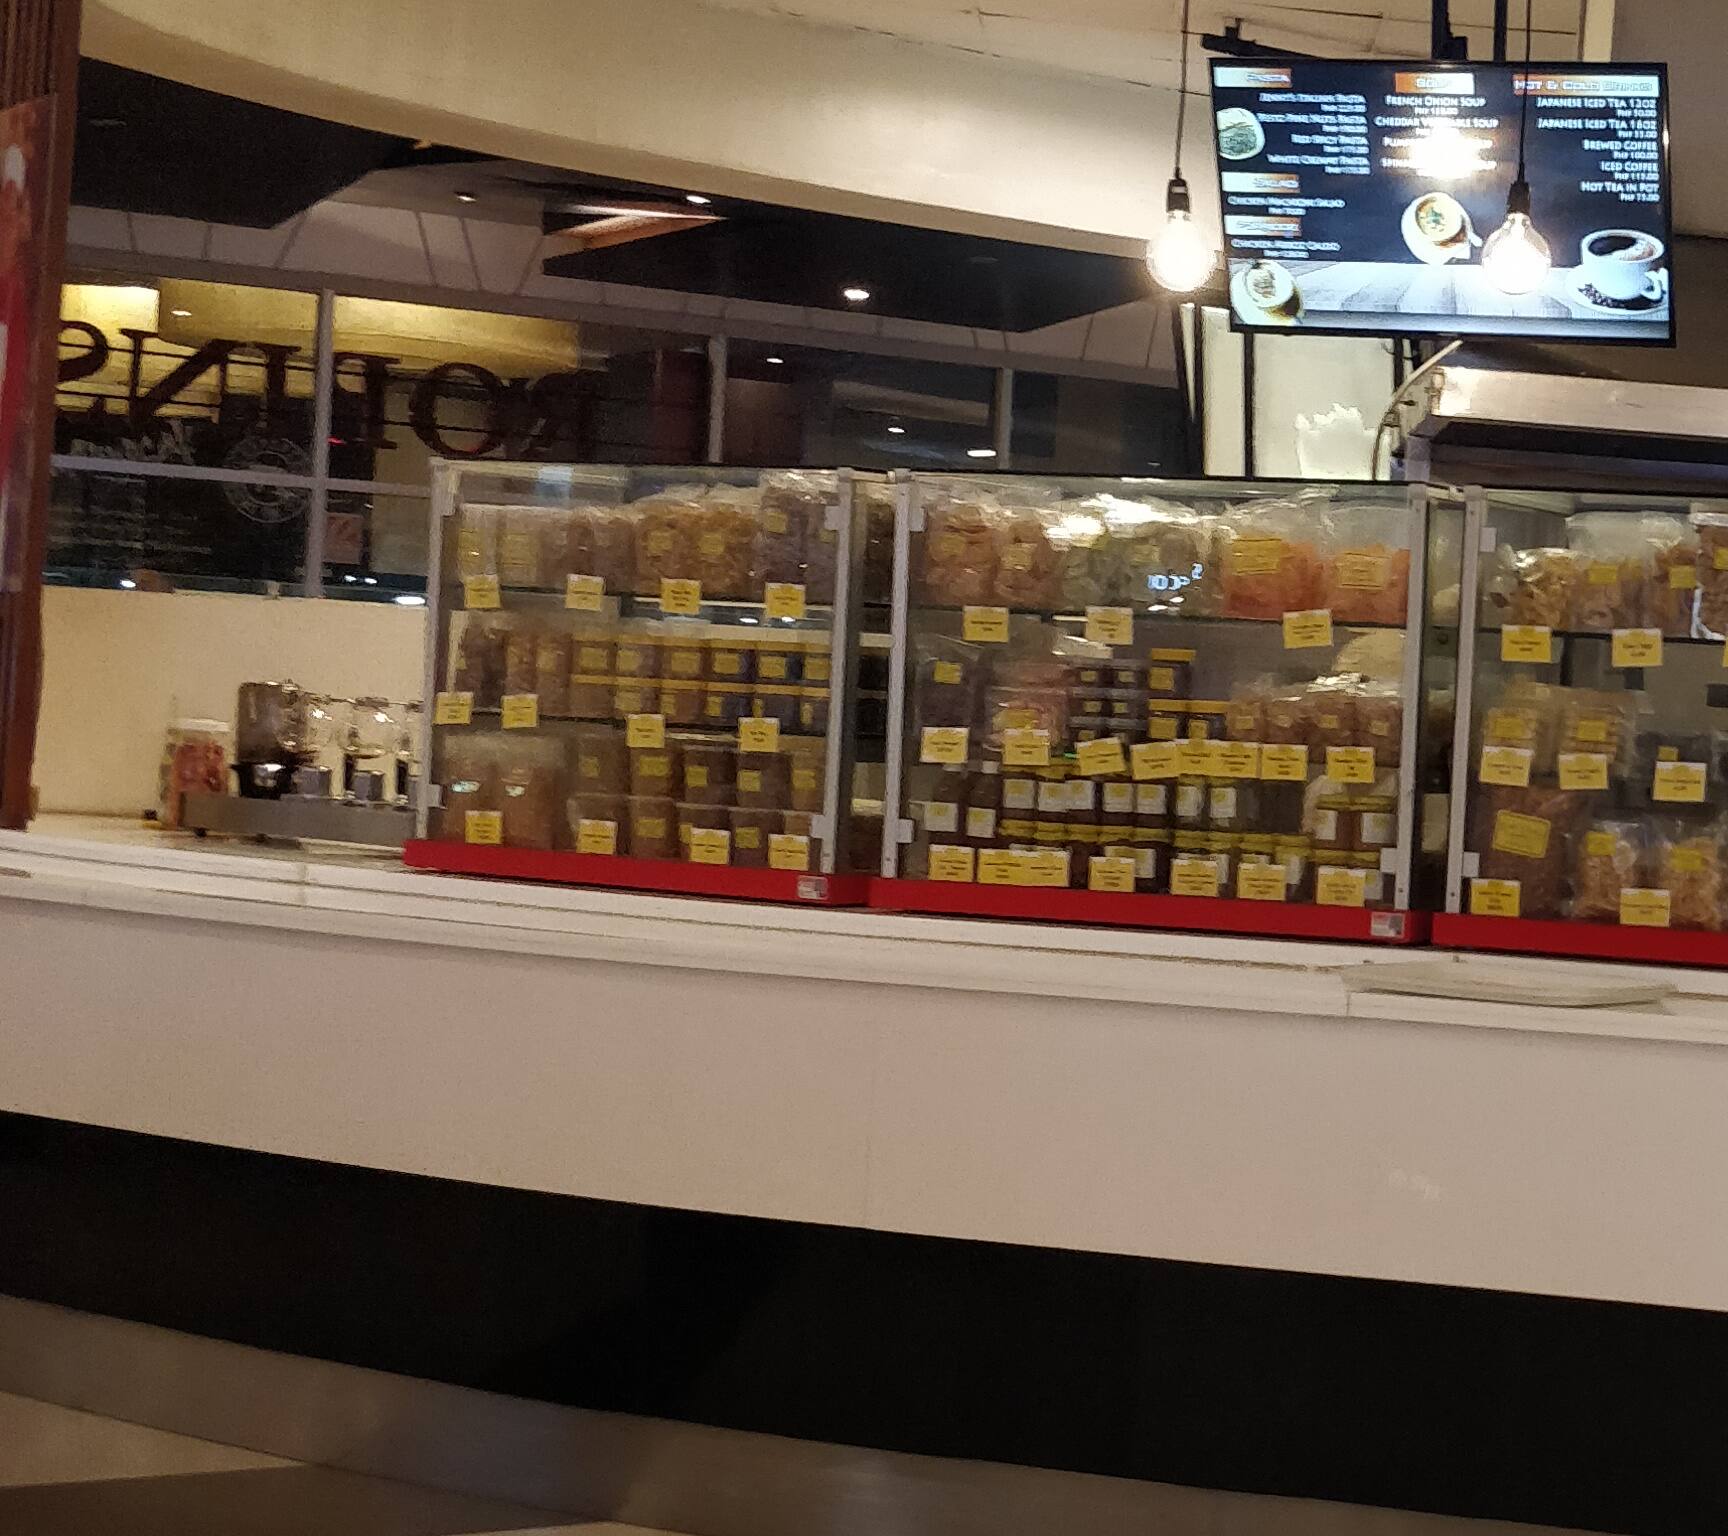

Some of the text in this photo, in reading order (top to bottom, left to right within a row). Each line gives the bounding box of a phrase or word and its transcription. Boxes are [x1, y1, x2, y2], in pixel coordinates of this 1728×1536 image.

[1385, 95, 1486, 107] FRENCH ONION SOUP
[1537, 97, 1582, 108] JAPANESE
[1585, 98, 1606, 108] ICED
[1607, 98, 1627, 108] TEA
[1374, 116, 1420, 126] CHEDDAR
[1538, 118, 1582, 129] JAPANESE
[1585, 119, 1606, 129] ICED
[1608, 119, 1627, 129] TEA
[1583, 139, 1657, 150] BREWED COFFEE
[1601, 161, 1658, 172] ICED COFFEE
[1581, 181, 1603, 192] HOT
[1605, 182, 1623, 192] TEA
[1640, 182, 1659, 192] POT
